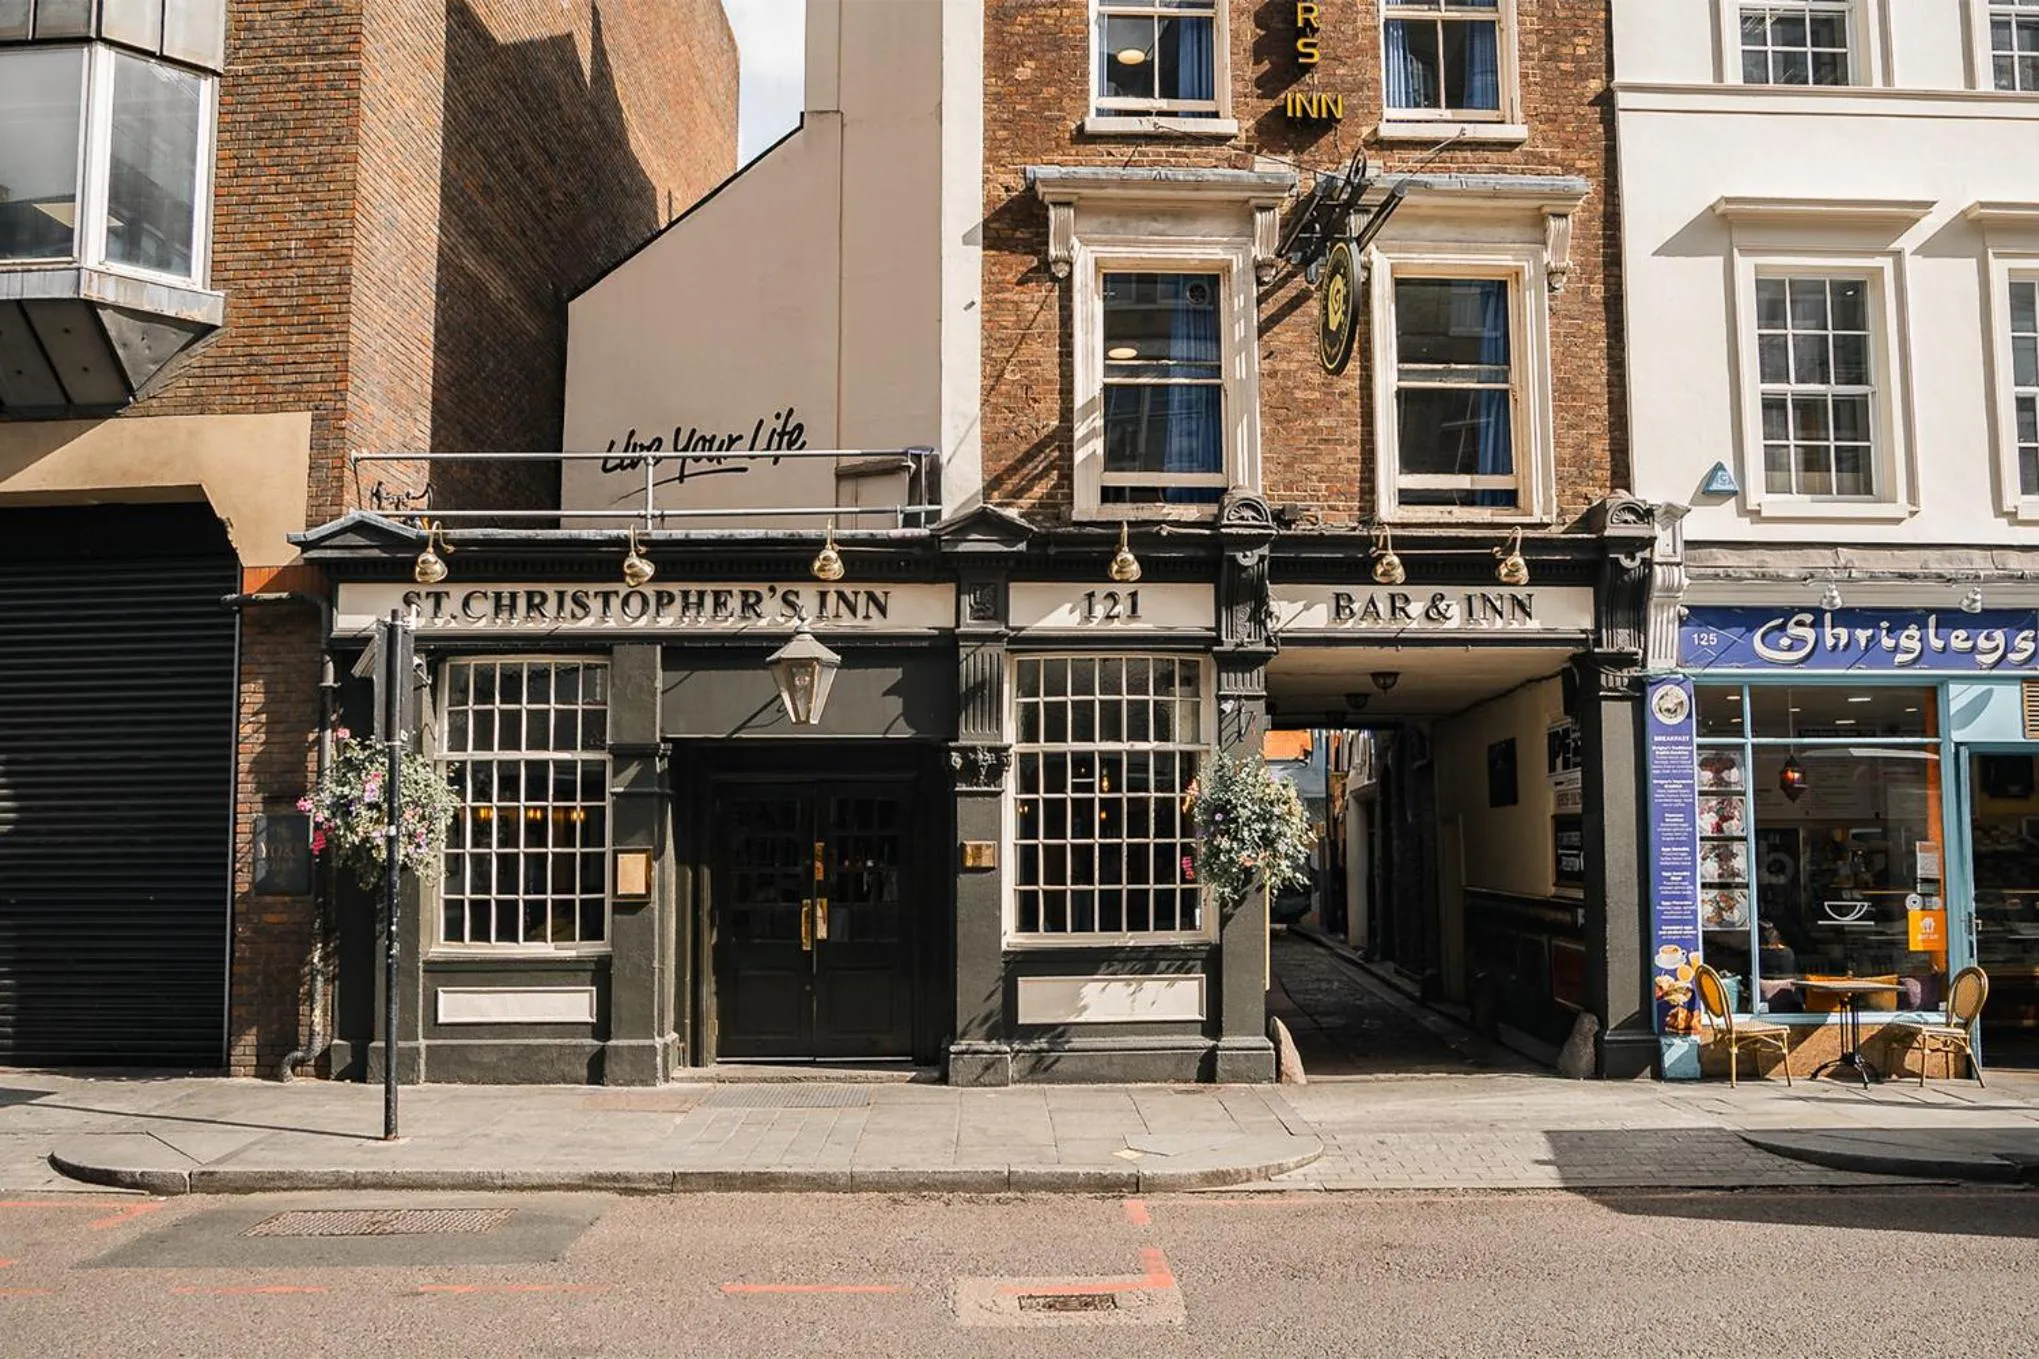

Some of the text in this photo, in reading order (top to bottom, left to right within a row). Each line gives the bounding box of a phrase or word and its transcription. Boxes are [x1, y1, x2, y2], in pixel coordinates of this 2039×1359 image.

[1286, 91, 1343, 119] INN
[602, 407, 808, 484] Live Your Life
[816, 589, 892, 621] INN
[1083, 590, 1143, 620] 121
[1333, 591, 1535, 622] BAR & INN
[1691, 632, 1718, 646] 125
[1752, 611, 2037, 668] Shrigleys
